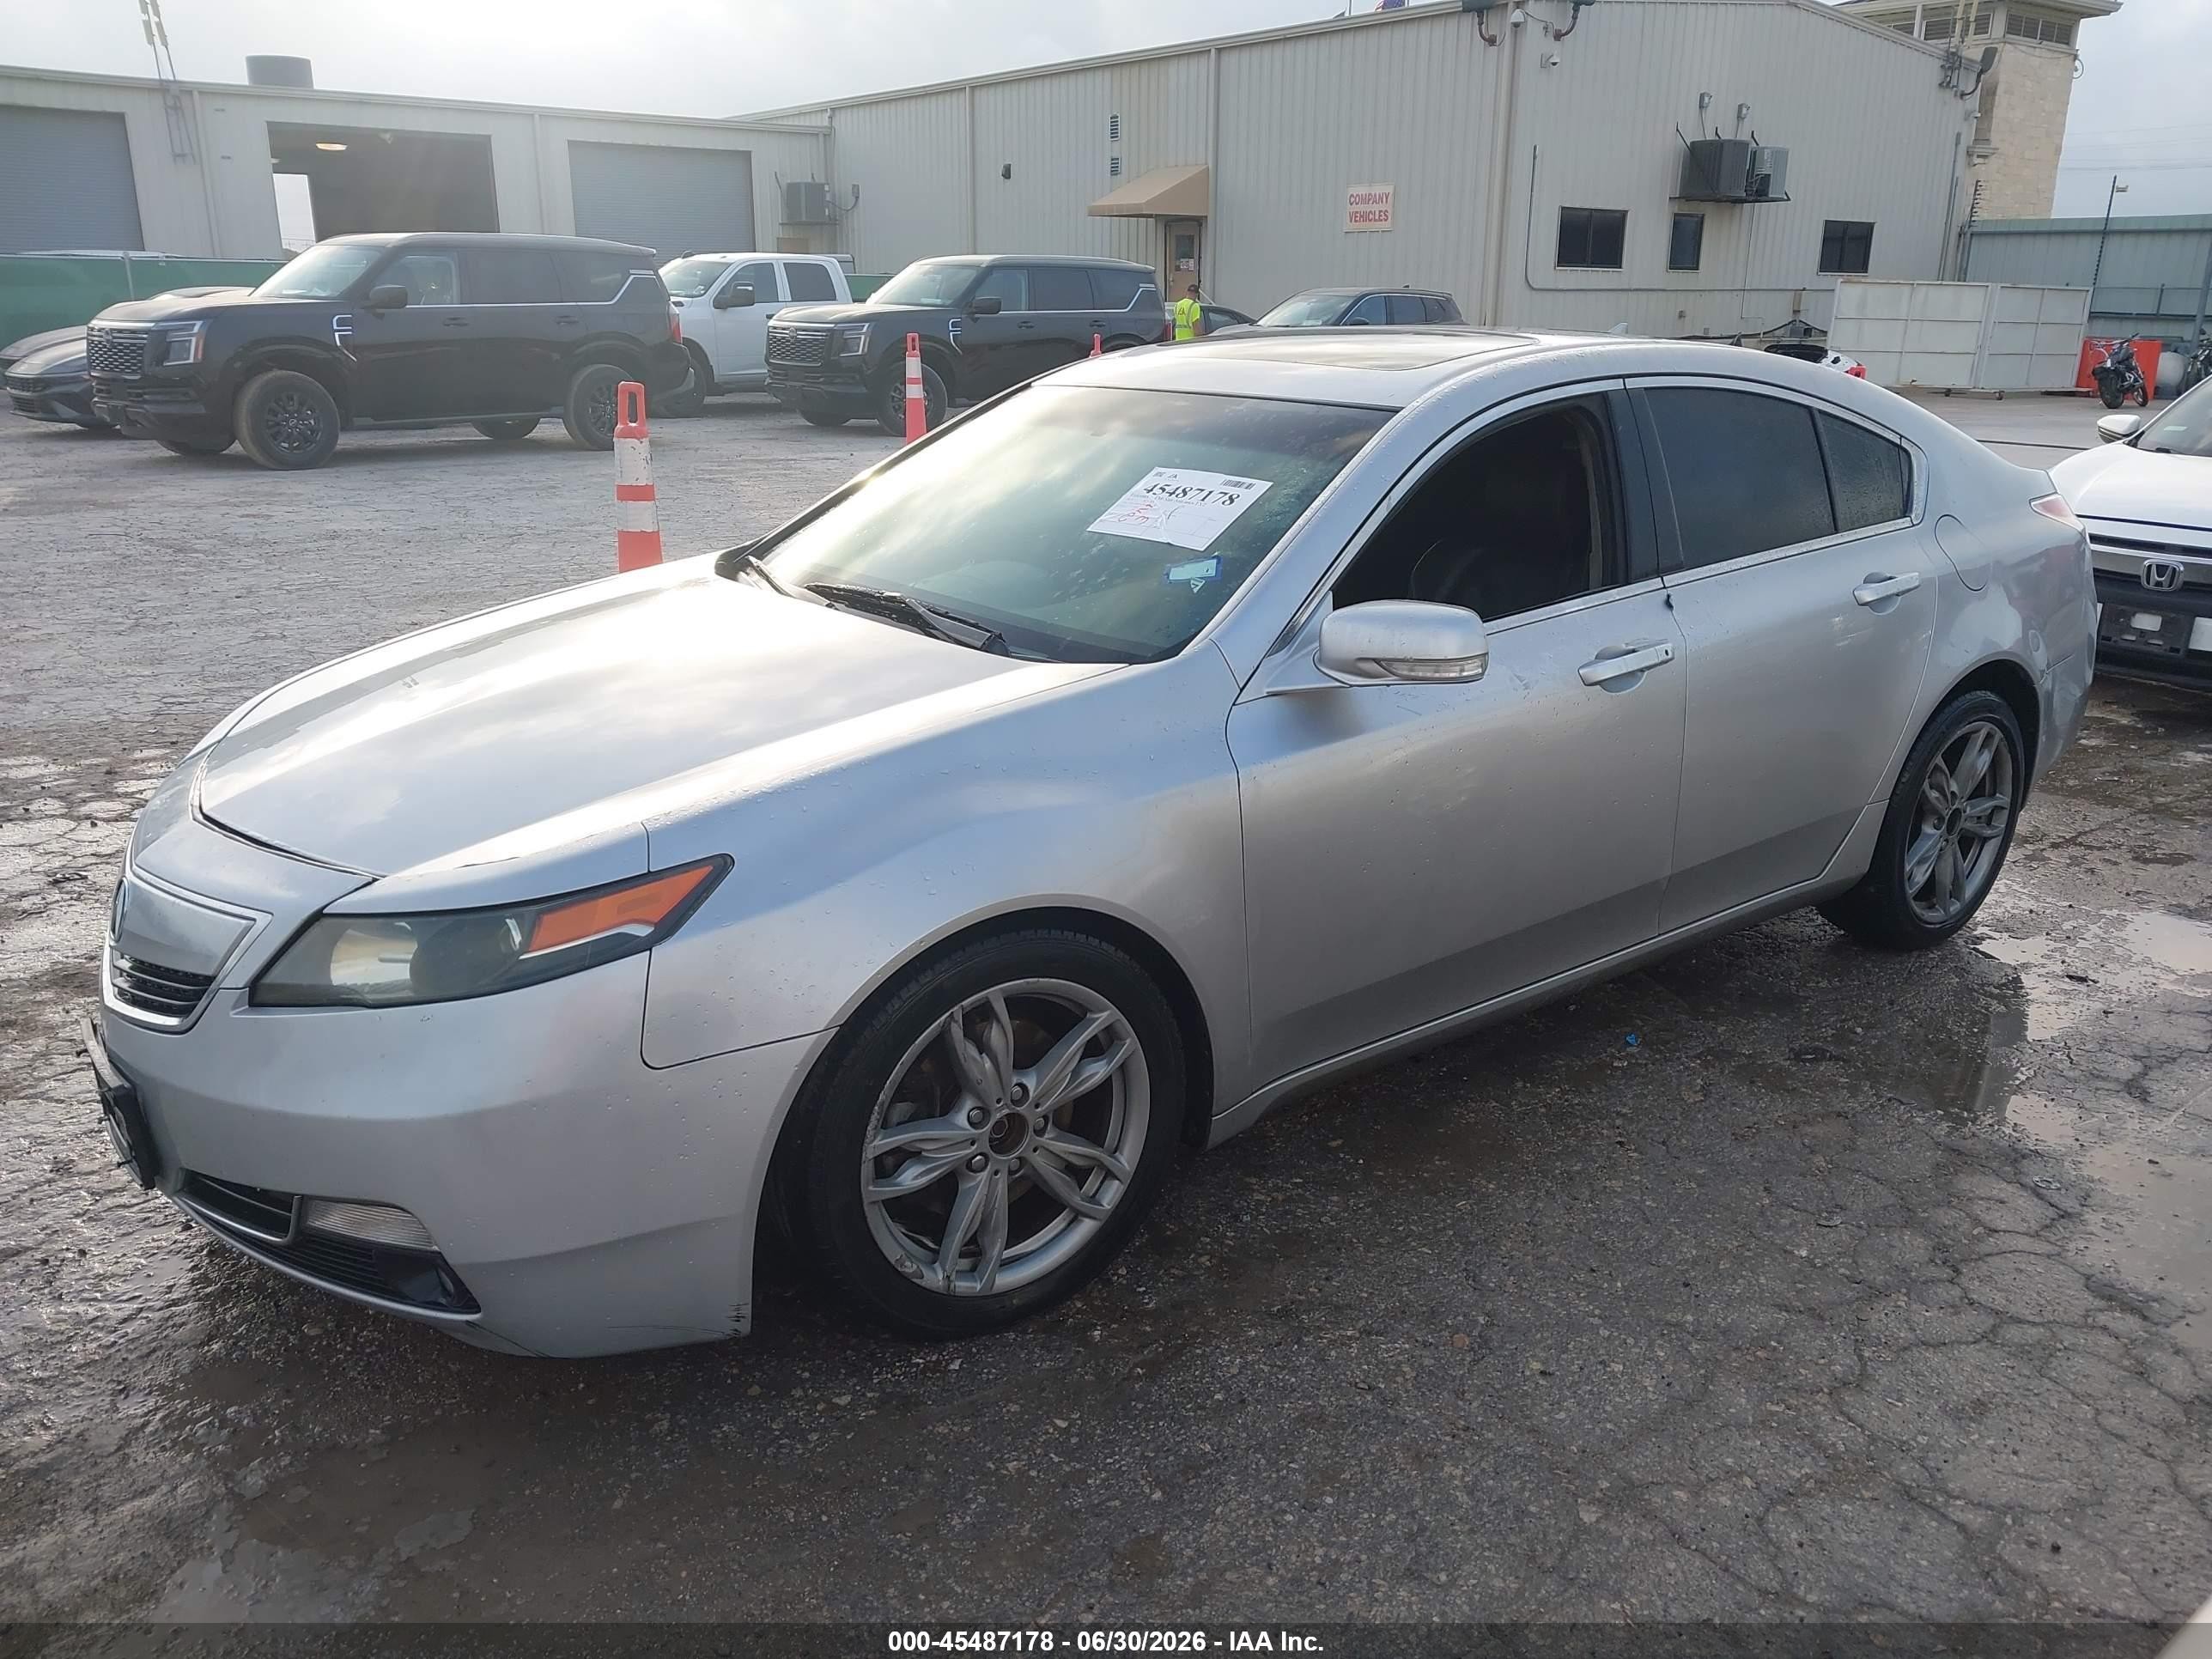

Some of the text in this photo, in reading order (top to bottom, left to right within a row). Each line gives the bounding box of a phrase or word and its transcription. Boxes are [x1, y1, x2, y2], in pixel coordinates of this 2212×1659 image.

[1348, 191, 1390, 206] COMPANY
[1348, 209, 1389, 223] VEHICLES
[1144, 483, 1241, 507] 45487178
